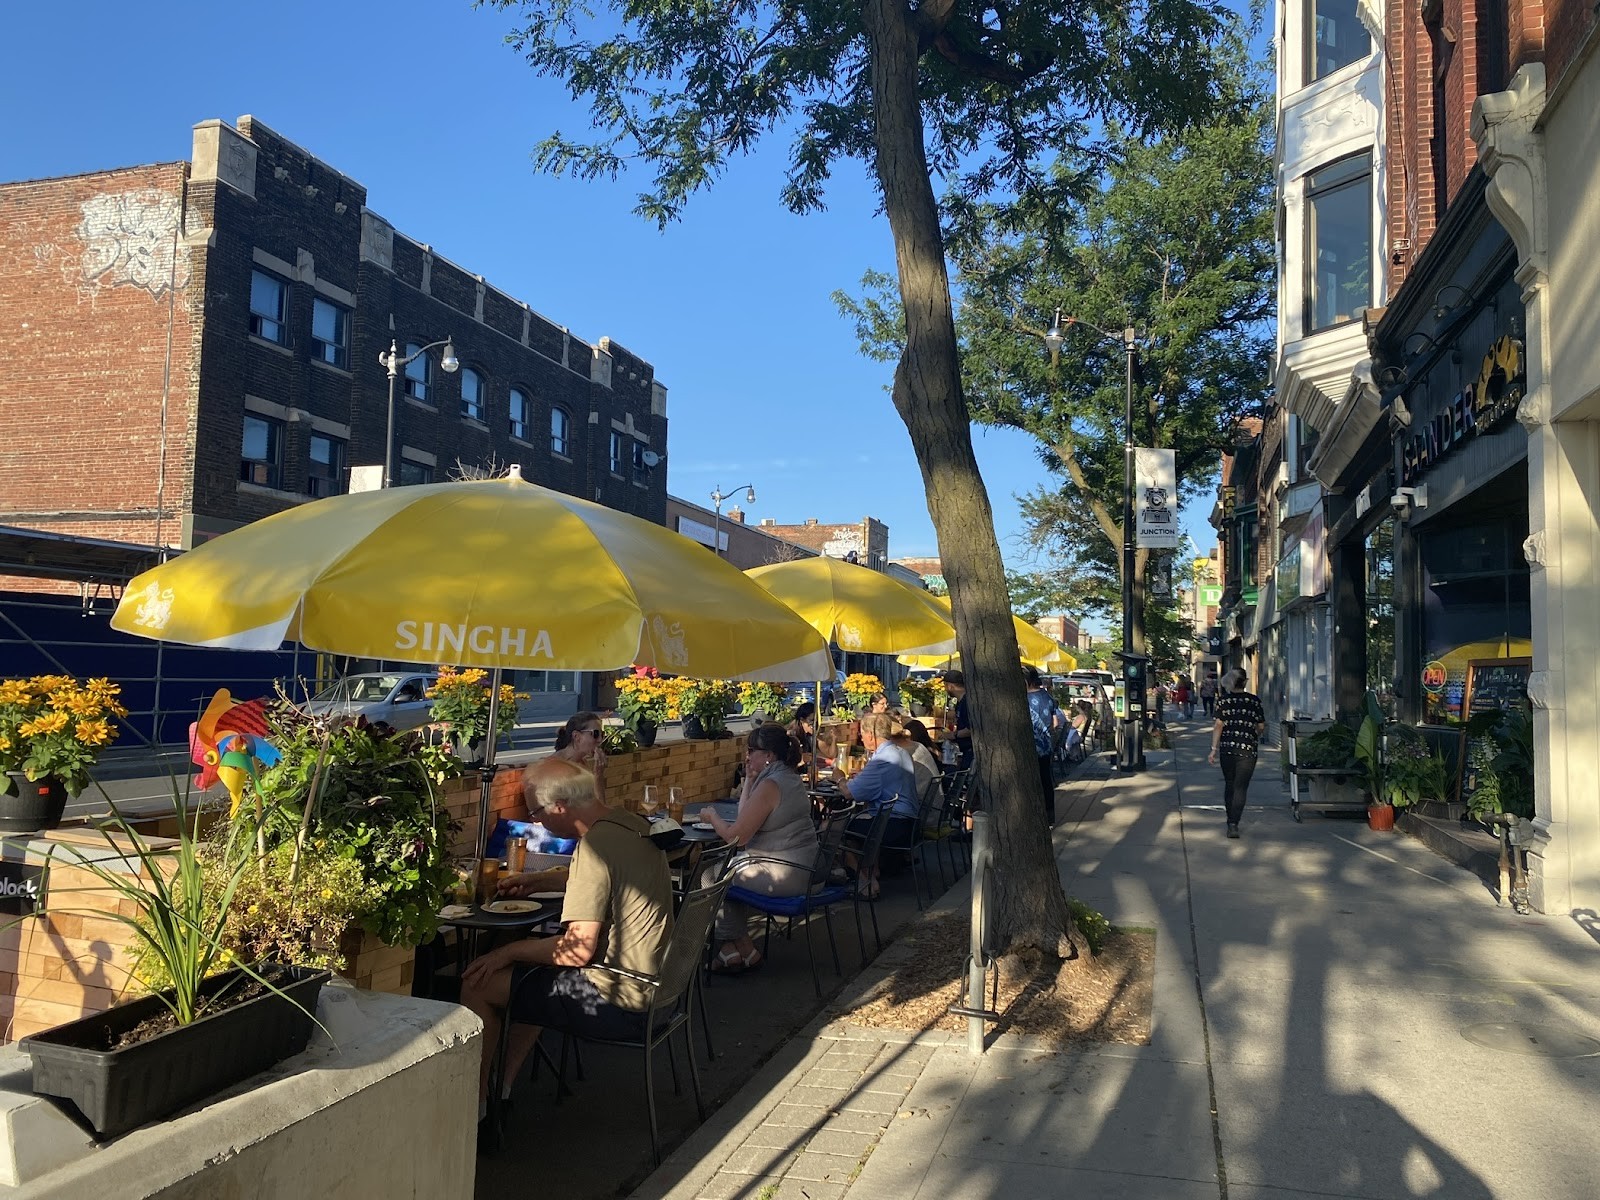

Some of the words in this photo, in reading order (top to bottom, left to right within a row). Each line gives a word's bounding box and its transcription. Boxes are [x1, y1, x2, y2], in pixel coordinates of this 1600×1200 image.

[1203, 589, 1223, 602] TD
[395, 620, 554, 658] SINGHA
[1424, 668, 1445, 685] OPEN
